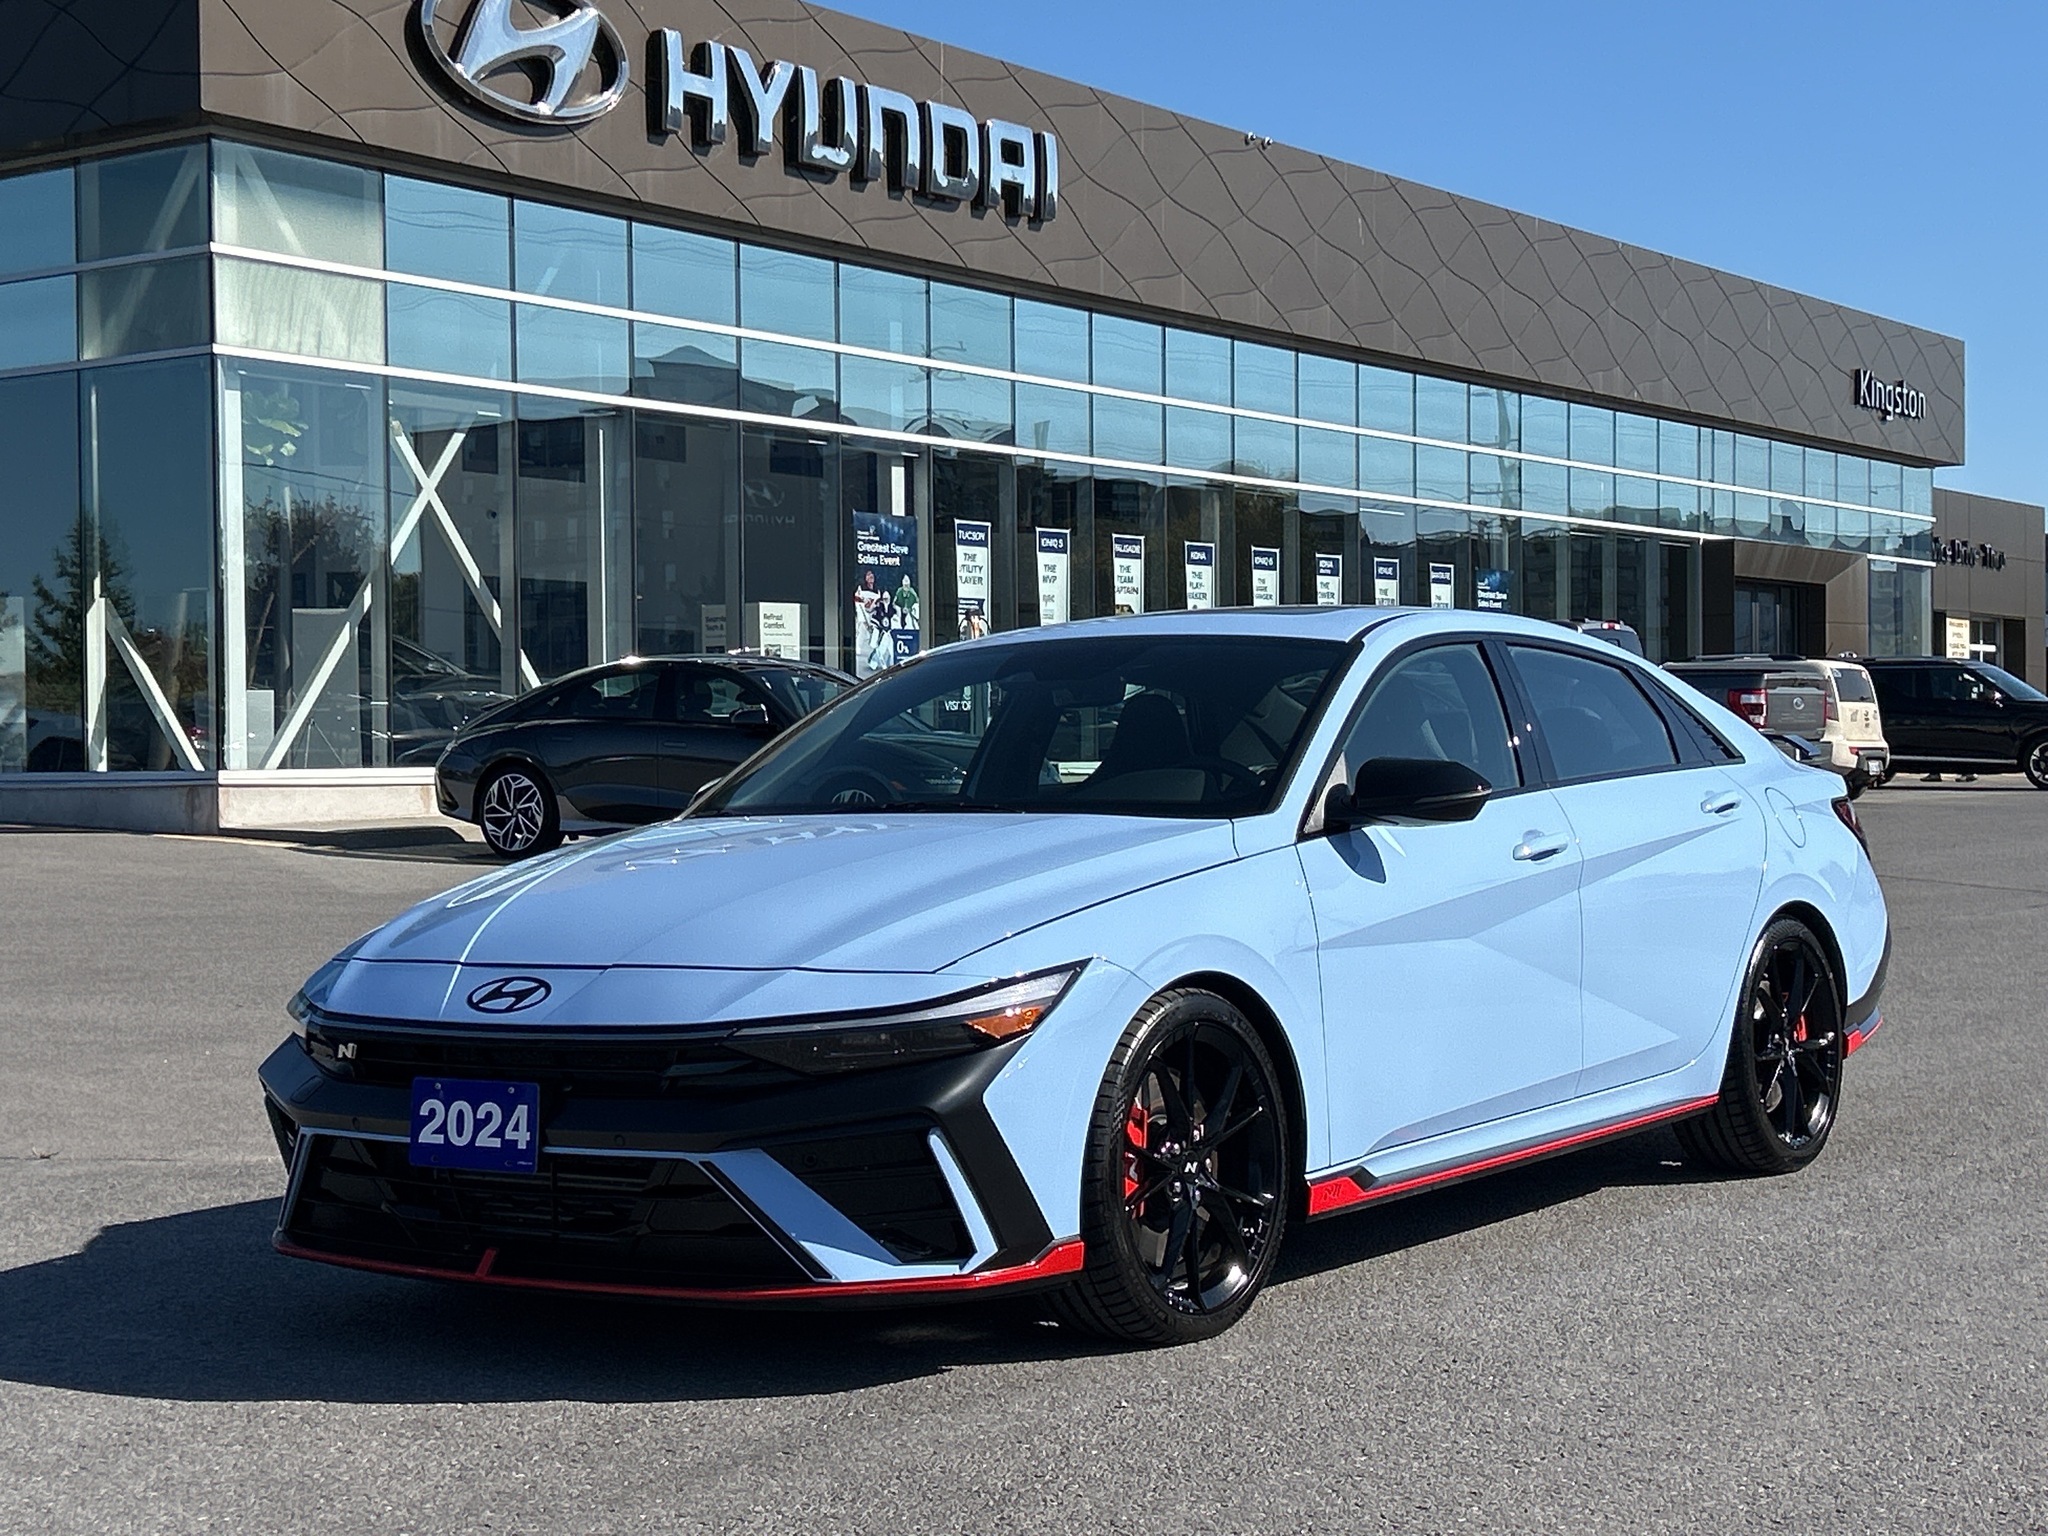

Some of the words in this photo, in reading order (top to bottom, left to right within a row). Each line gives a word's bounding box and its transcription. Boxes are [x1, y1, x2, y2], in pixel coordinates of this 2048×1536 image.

[650, 27, 1058, 223] HYUNDAI
[1857, 369, 1927, 421] Kingston
[958, 529, 986, 541] TUCSON
[857, 541, 890, 554] Greatest
[857, 553, 879, 565] Sales
[879, 554, 901, 566] Event
[963, 553, 978, 563] THE
[1043, 563, 1058, 573] THE
[1119, 564, 1132, 574] THE
[418, 1098, 531, 1150] 2024
